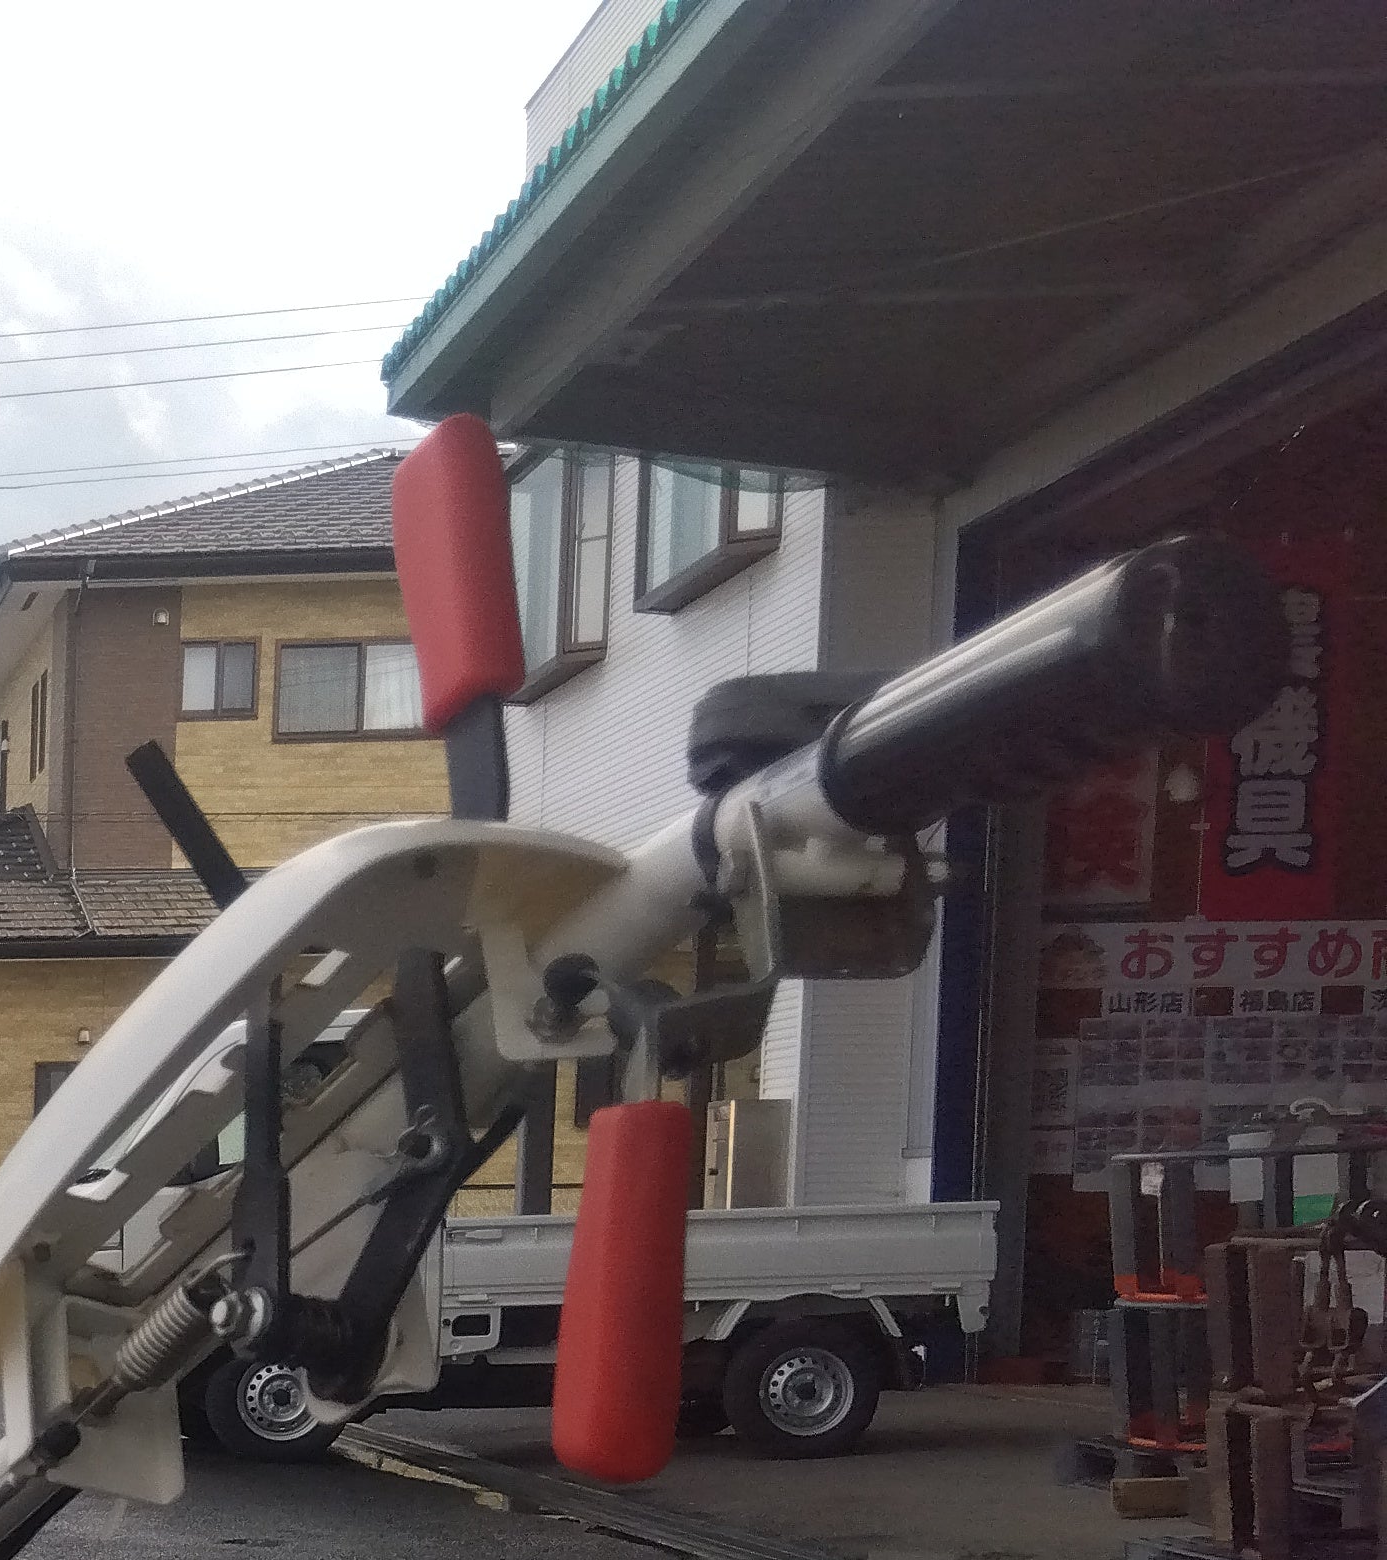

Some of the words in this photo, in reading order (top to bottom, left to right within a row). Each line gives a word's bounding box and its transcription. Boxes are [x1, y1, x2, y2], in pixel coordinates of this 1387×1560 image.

[1108, 990, 1183, 1014] 山形店
[1239, 989, 1315, 1013] 福島店
